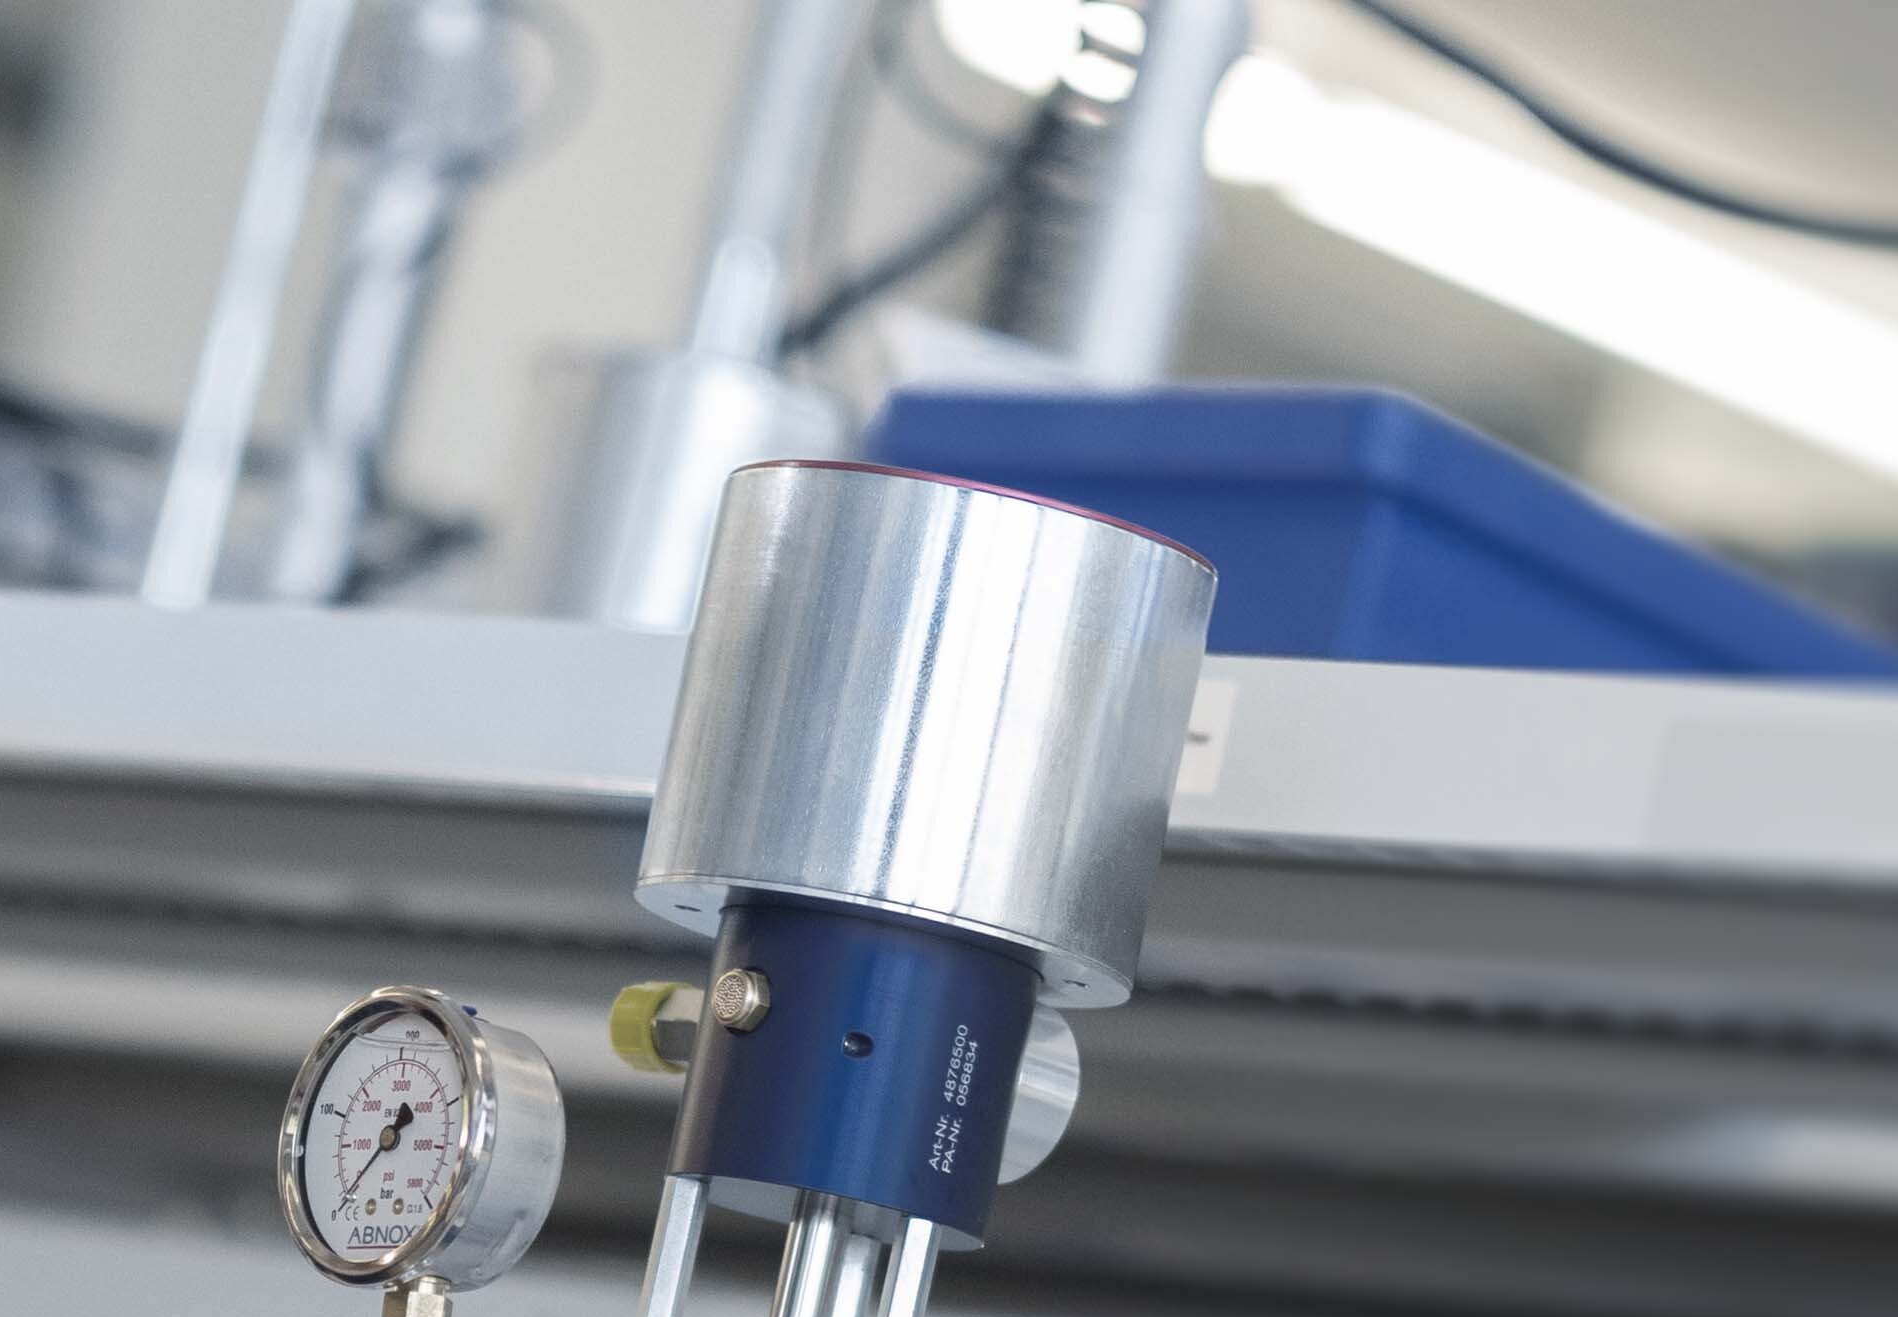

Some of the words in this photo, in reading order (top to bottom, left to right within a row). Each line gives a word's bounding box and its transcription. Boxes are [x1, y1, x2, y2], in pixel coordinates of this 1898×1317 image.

[391, 1080, 411, 1092] 3000
[929, 1114, 950, 1171] Art-Nr.
[944, 1024, 968, 1102] 4876500
[320, 1103, 334, 1115] 100
[362, 1100, 382, 1112] 2000
[414, 1101, 433, 1114] 4000
[942, 1118, 962, 1174] PA-Nr.
[956, 1041, 978, 1106] 056834
[352, 1139, 372, 1150] 1000
[413, 1140, 433, 1151] 5000
[383, 1169, 395, 1182] psi
[380, 1187, 394, 1199] bar
[331, 1209, 337, 1221] 0
[348, 1225, 417, 1245] ABNOX
